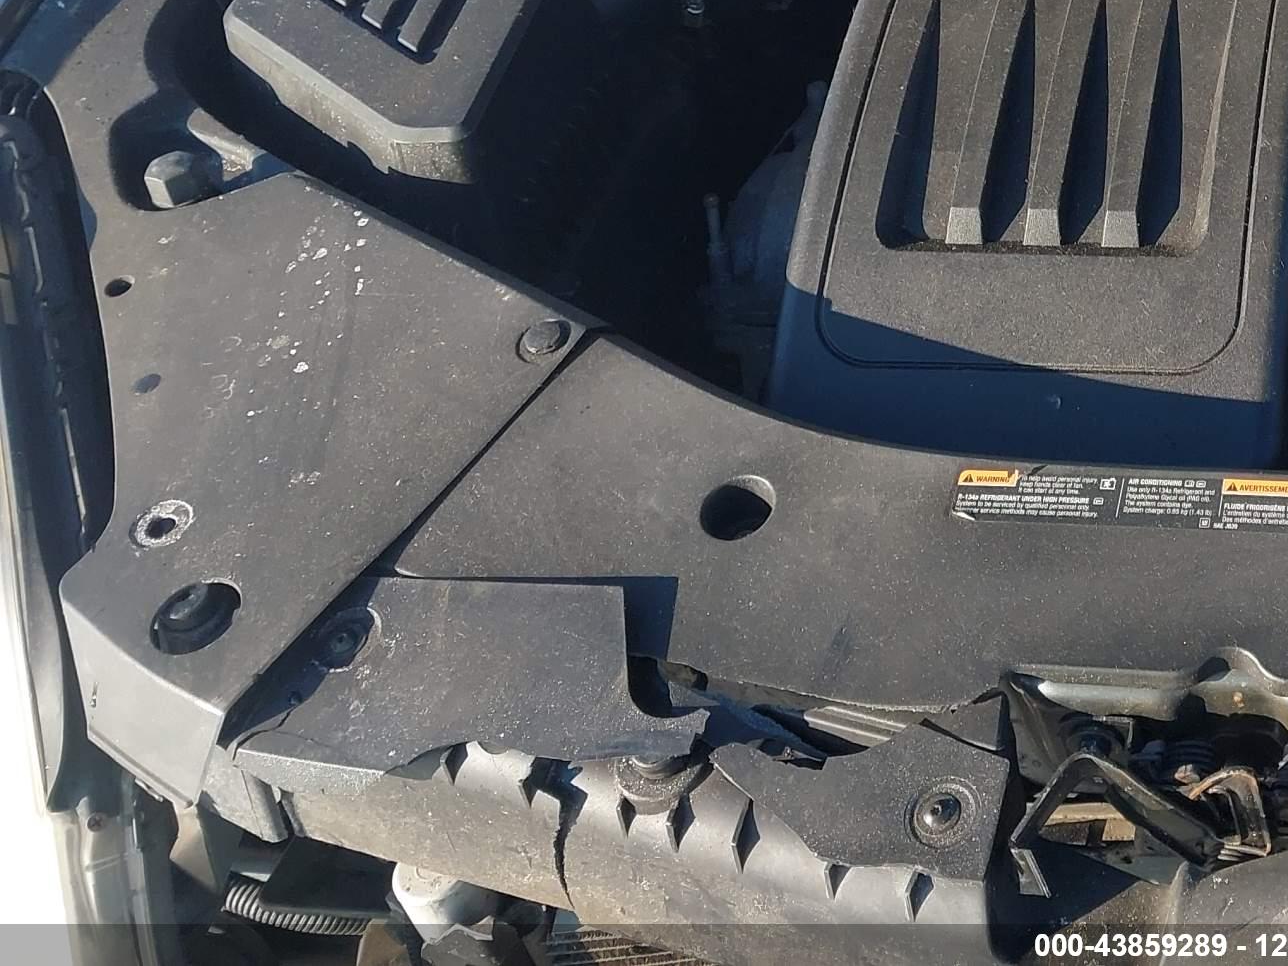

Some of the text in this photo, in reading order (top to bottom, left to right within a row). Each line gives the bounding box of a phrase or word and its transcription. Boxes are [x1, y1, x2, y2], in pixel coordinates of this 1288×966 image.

[1140, 478, 1183, 487] CONDITIONING
[957, 493, 979, 501] R-134a
[979, 494, 1021, 502] REFRIGERANT
[1223, 502, 1245, 510] FLUIDE
